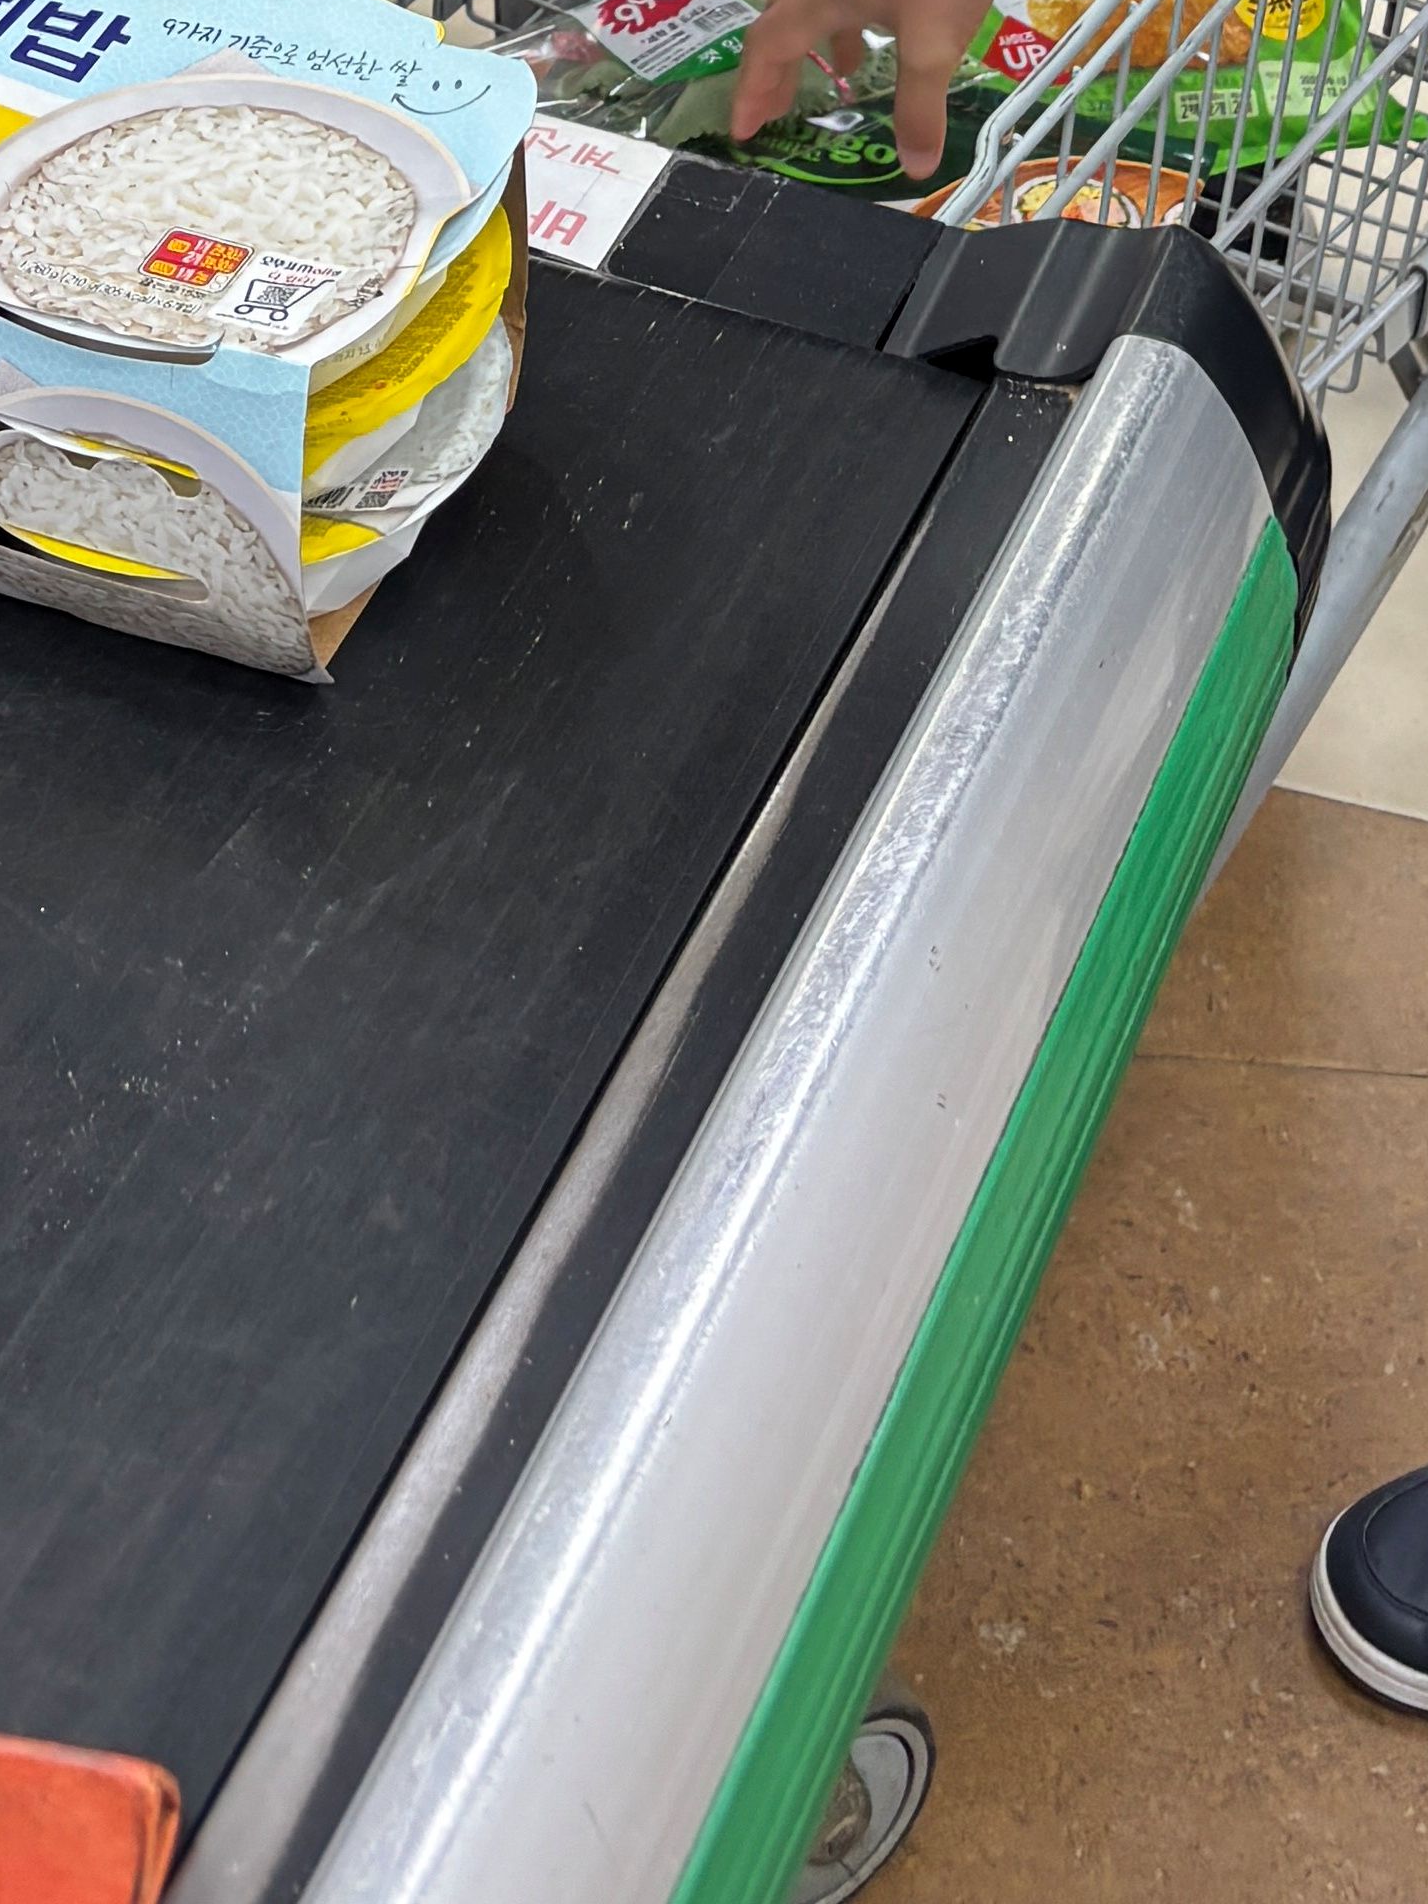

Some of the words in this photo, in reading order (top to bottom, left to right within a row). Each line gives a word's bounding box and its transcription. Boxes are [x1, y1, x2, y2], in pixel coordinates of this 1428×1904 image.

[229, 34, 297, 67] 기준으로
[306, 49, 383, 81] 엄선한
[388, 59, 421, 87] 쌀
